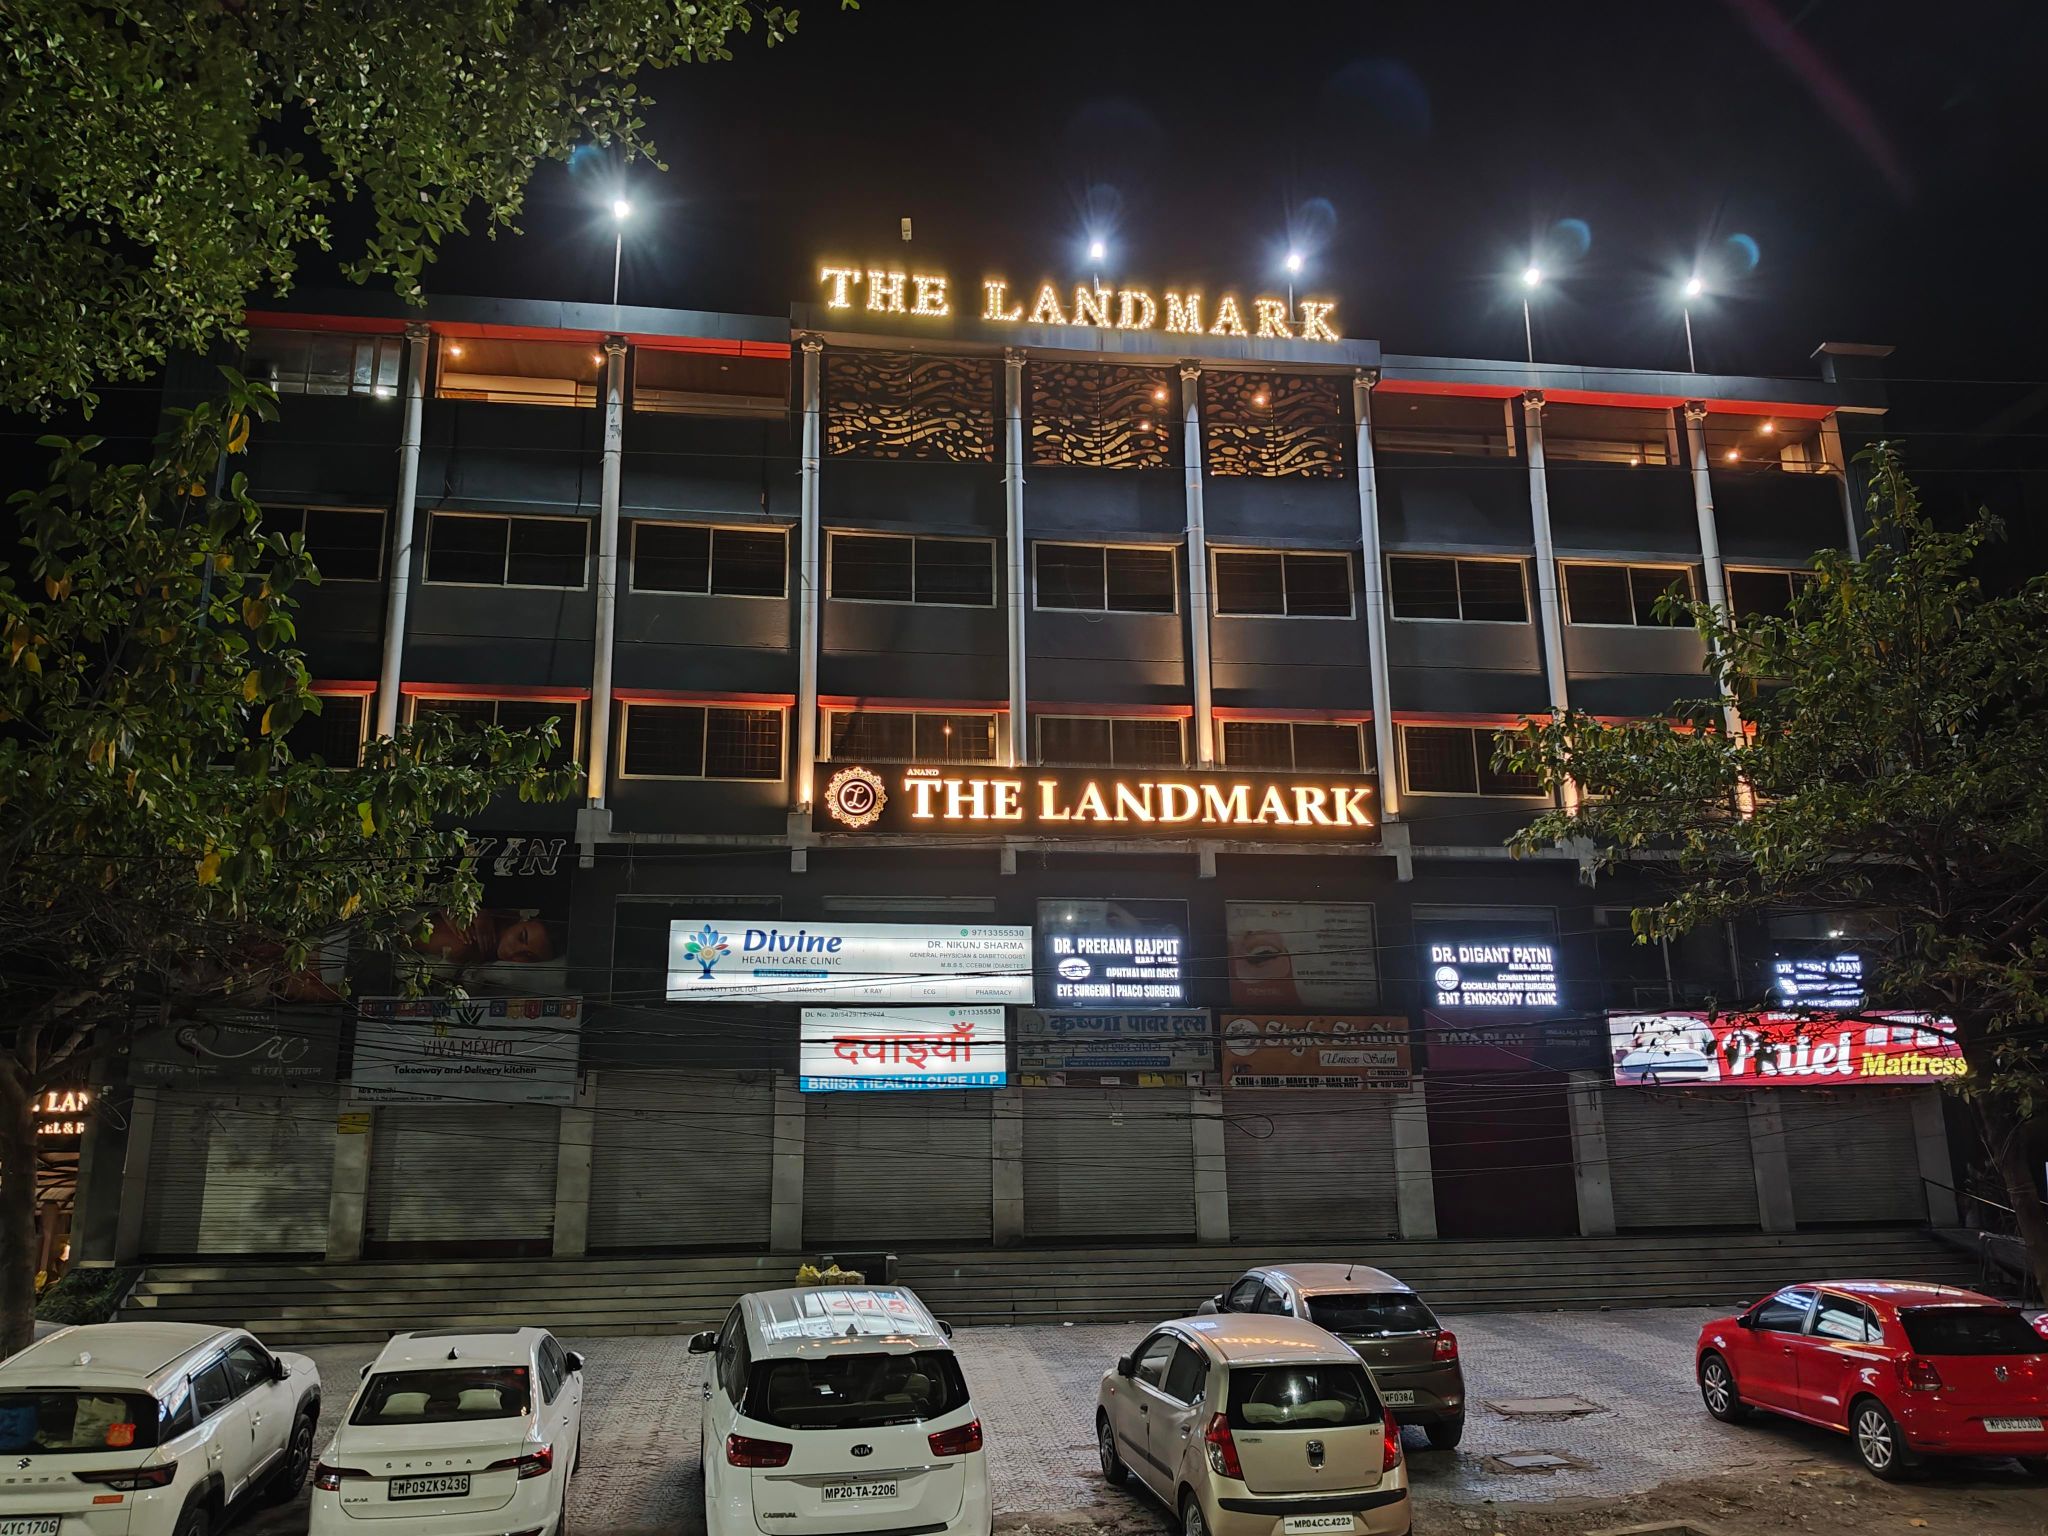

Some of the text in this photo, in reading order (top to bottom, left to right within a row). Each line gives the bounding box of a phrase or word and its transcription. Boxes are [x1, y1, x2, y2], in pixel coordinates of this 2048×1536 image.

[817, 265, 1341, 342] THE LANDMARK
[907, 768, 939, 776] ANAND
[903, 778, 1375, 828] THE LANDMARK
[971, 929, 1024, 938] 9713355530
[743, 929, 843, 953] Divine
[927, 940, 1024, 950] DR. NIKUNJ SHARMA
[1053, 937, 1179, 955] DR. PRERANA RAJPUT
[741, 955, 842, 966] HEALTH CARE CLINIC
[1431, 946, 1552, 964] DR. DIGANT PATNI
[923, 988, 936, 996] ECG
[975, 989, 1012, 997] PHARMACY
[1056, 983, 1181, 998] EYE SURGEON PHACO SURGEON
[1460, 982, 1557, 992] COCHLEAR IMPLANT SURGEON
[1437, 992, 1558, 1006] ENT ENDOSCOPY CLINIC
[957, 1008, 1001, 1016] 9713355530
[1049, 1014, 1122, 1035] कृष्णा
[1126, 1015, 1169, 1032] पावर
[422, 1040, 457, 1057] VIVA
[832, 1021, 976, 1070] दवाइयाँ
[1320, 1052, 1396, 1065] Unisex Salon
[1860, 1052, 1969, 1077] Mattress
[393, 1065, 537, 1076] Takeaway and Delivery kitchen
[863, 1076, 923, 1090] HEALTH
[1260, 1076, 1280, 1087] HAIR
[62, 1121, 74, 1134] &
[853, 1446, 871, 1456] KIA
[397, 1478, 468, 1495] MP09ZK9436
[824, 1484, 897, 1500] MP20-TA-2206
